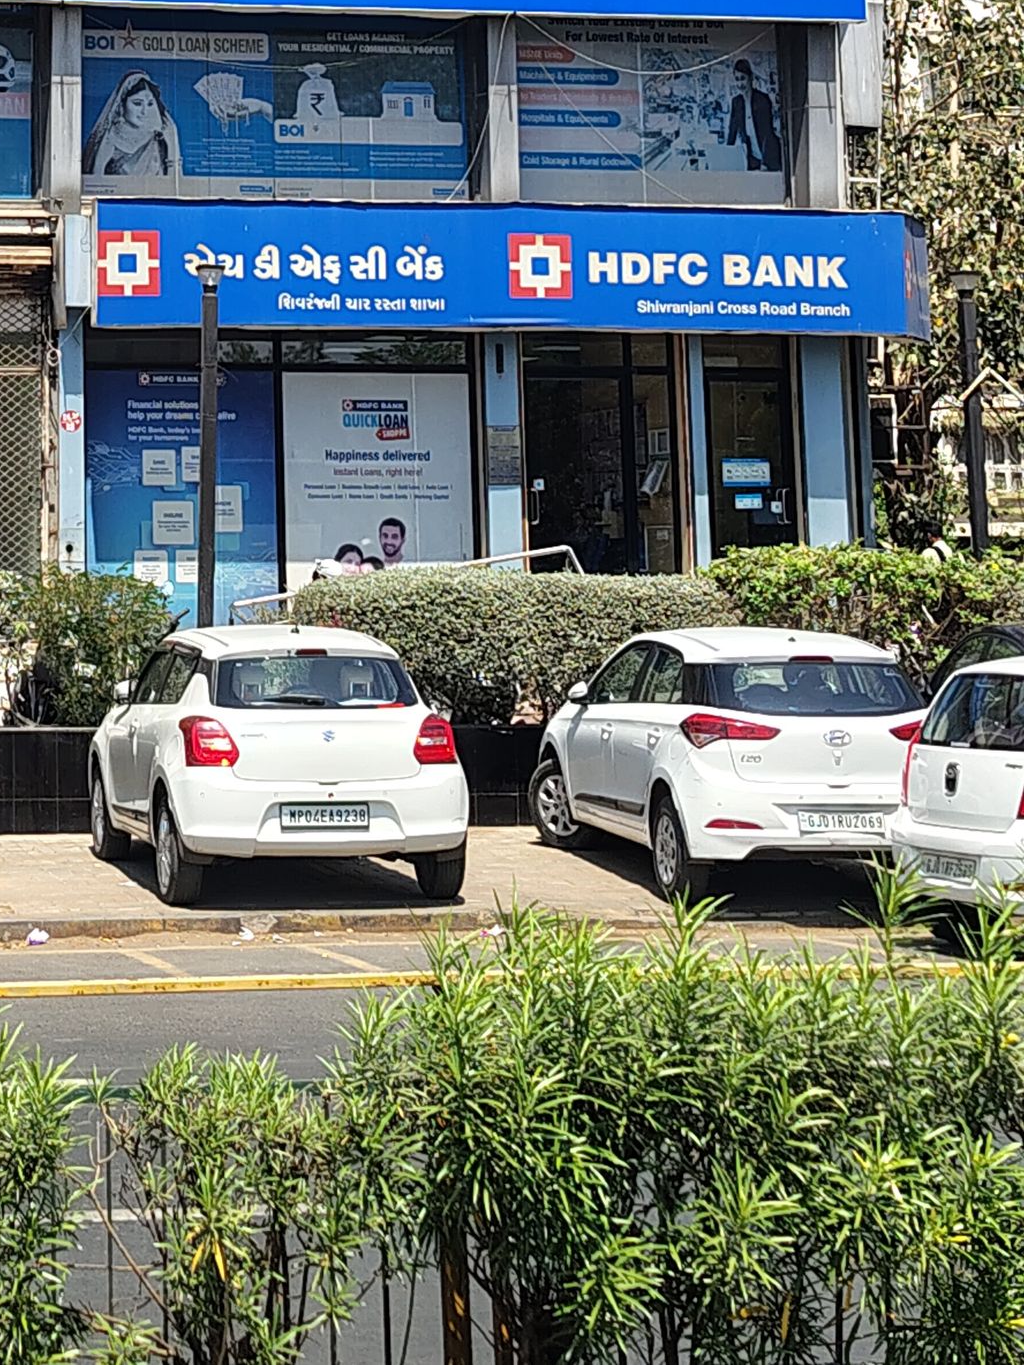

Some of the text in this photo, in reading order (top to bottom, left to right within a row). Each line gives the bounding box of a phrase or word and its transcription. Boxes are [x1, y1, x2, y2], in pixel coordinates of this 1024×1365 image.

[565, 30, 708, 44] For Lowest Rate Of Interest
[84, 35, 264, 54] BOI GOLD LOAN SCHEME
[279, 124, 305, 137] BOI
[254, 245, 280, 279] ડી
[290, 245, 341, 284] એફ
[350, 245, 387, 281] સી
[396, 246, 444, 281] બેંક
[587, 251, 849, 289] HDFC BANK
[345, 297, 371, 311] ચાર
[374, 297, 406, 312] રસ્તા
[410, 297, 445, 312] શાખા
[636, 300, 851, 318] Shivranjani Cross Road Branch
[127, 400, 163, 410] Financial
[356, 402, 379, 410] HDFC
[325, 449, 431, 463] Happiness delivered
[333, 467, 358, 476] Instant
[385, 468, 403, 479] right
